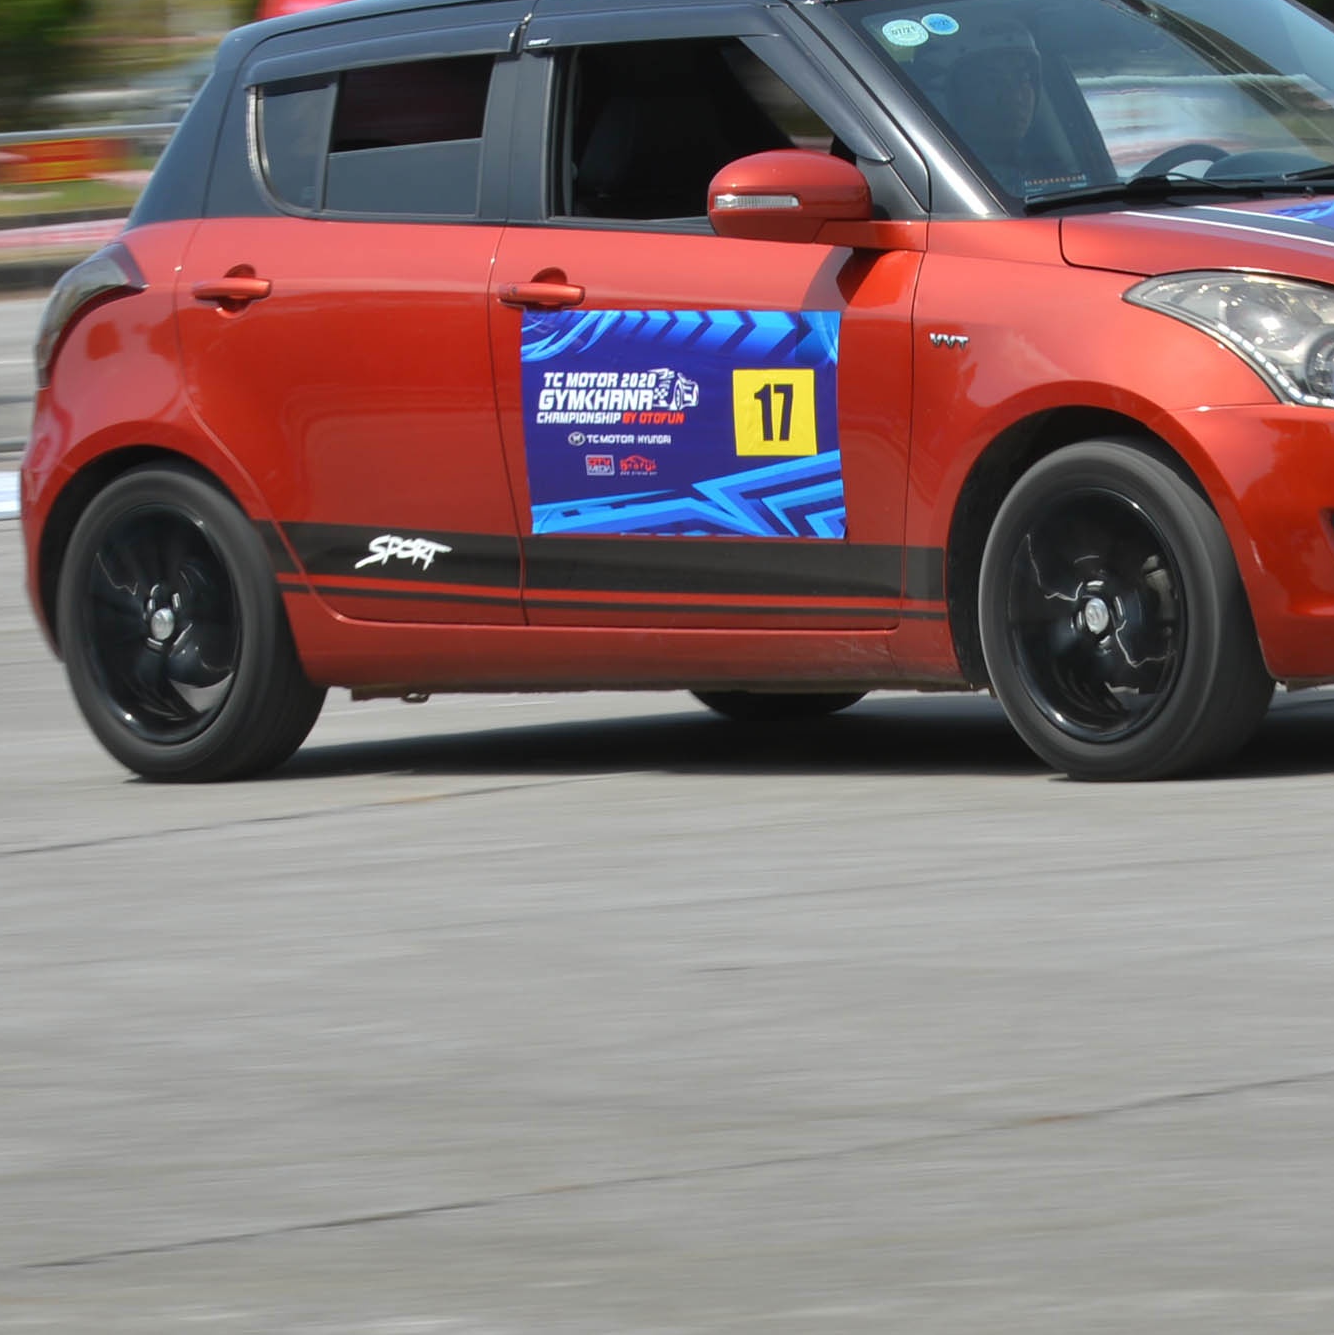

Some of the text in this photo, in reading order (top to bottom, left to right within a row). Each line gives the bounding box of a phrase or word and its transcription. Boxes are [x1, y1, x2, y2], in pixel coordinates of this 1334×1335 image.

[929, 332, 970, 350] VVT
[543, 372, 657, 388] TC MOTOR 2020
[538, 388, 654, 411] GYMKHANA
[536, 411, 622, 424] CHAMPIONSHIP
[753, 383, 794, 442] 17
[354, 533, 453, 571] SPORT
